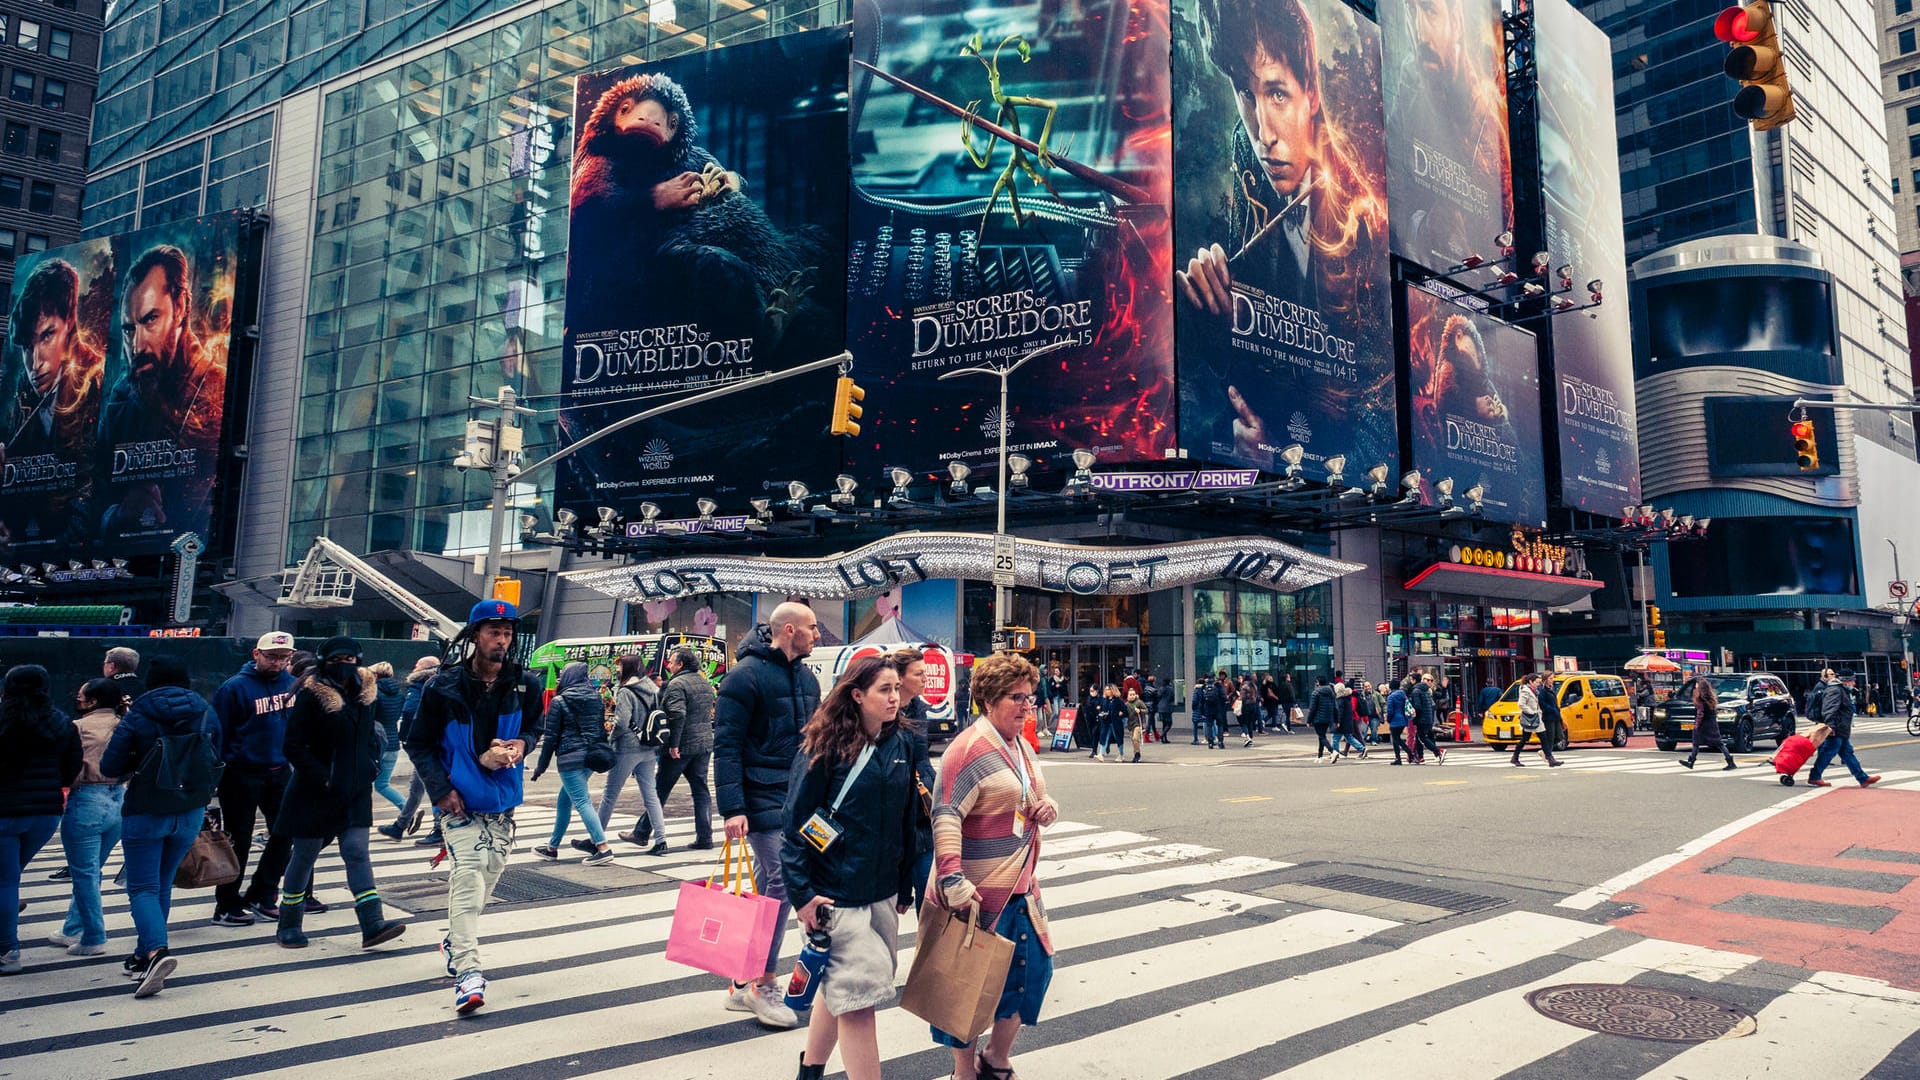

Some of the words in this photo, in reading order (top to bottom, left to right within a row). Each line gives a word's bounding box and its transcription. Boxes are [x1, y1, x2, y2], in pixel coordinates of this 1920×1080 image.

[1413, 143, 1488, 207] DUMBLEDORE
[940, 312, 956, 324] THE
[956, 289, 1034, 321] SECRETS
[1034, 296, 1048, 308] OF
[1254, 300, 1266, 312] THE
[1266, 294, 1320, 330] SECRETS
[603, 342, 618, 352] THE
[618, 323, 698, 350] SECRETS
[698, 332, 710, 342] OF
[912, 300, 1092, 358] DUMBLEDORE
[1230, 290, 1356, 364] DUMBLEDORE
[572, 338, 754, 384] DUMBLEDORE
[912, 358, 945, 371] RETURN
[950, 355, 962, 364] TO
[964, 352, 982, 363] THE
[985, 346, 1018, 360] MAGIC
[1023, 340, 1039, 348] ONLY
[1232, 338, 1260, 353] RETURN
[1262, 345, 1272, 356] TO
[1274, 350, 1287, 360] THE
[1288, 354, 1312, 368] MAGIC
[1334, 363, 1358, 382] 04.15
[572, 386, 606, 398] RETURN
[610, 385, 623, 394] TO
[626, 382, 644, 392] THE
[646, 379, 680, 391] MAGIC
[1582, 382, 1614, 407] SECRETS
[1562, 382, 1634, 432] DUMBLEDORE
[1446, 420, 1517, 462] DUMBLEDORE
[1465, 420, 1497, 440] SECRETS
[112, 447, 198, 475] DUMBLEDORE
[946, 452, 961, 460] Dolby
[962, 450, 982, 458] Cinema
[1034, 440, 1058, 448] IMAX
[2, 462, 78, 488] DUMBLEDORE
[642, 462, 670, 470] WORLD
[1093, 474, 1188, 488] OUTFRONT
[1202, 472, 1250, 486] PRIME
[604, 481, 618, 490] Dolby
[618, 480, 640, 488] Cinema
[642, 477, 677, 486] EXPERIENCE
[691, 475, 715, 483] IMAX
[838, 552, 928, 592] LOFT
[996, 556, 1012, 570] 25
[1038, 555, 1169, 595] LOFT
[632, 566, 721, 598] LOFT
[1031, 608, 1113, 634] LOFT
[565, 646, 586, 660] THE
[704, 652, 725, 664] TOUR
[924, 664, 946, 676] OVID-19
